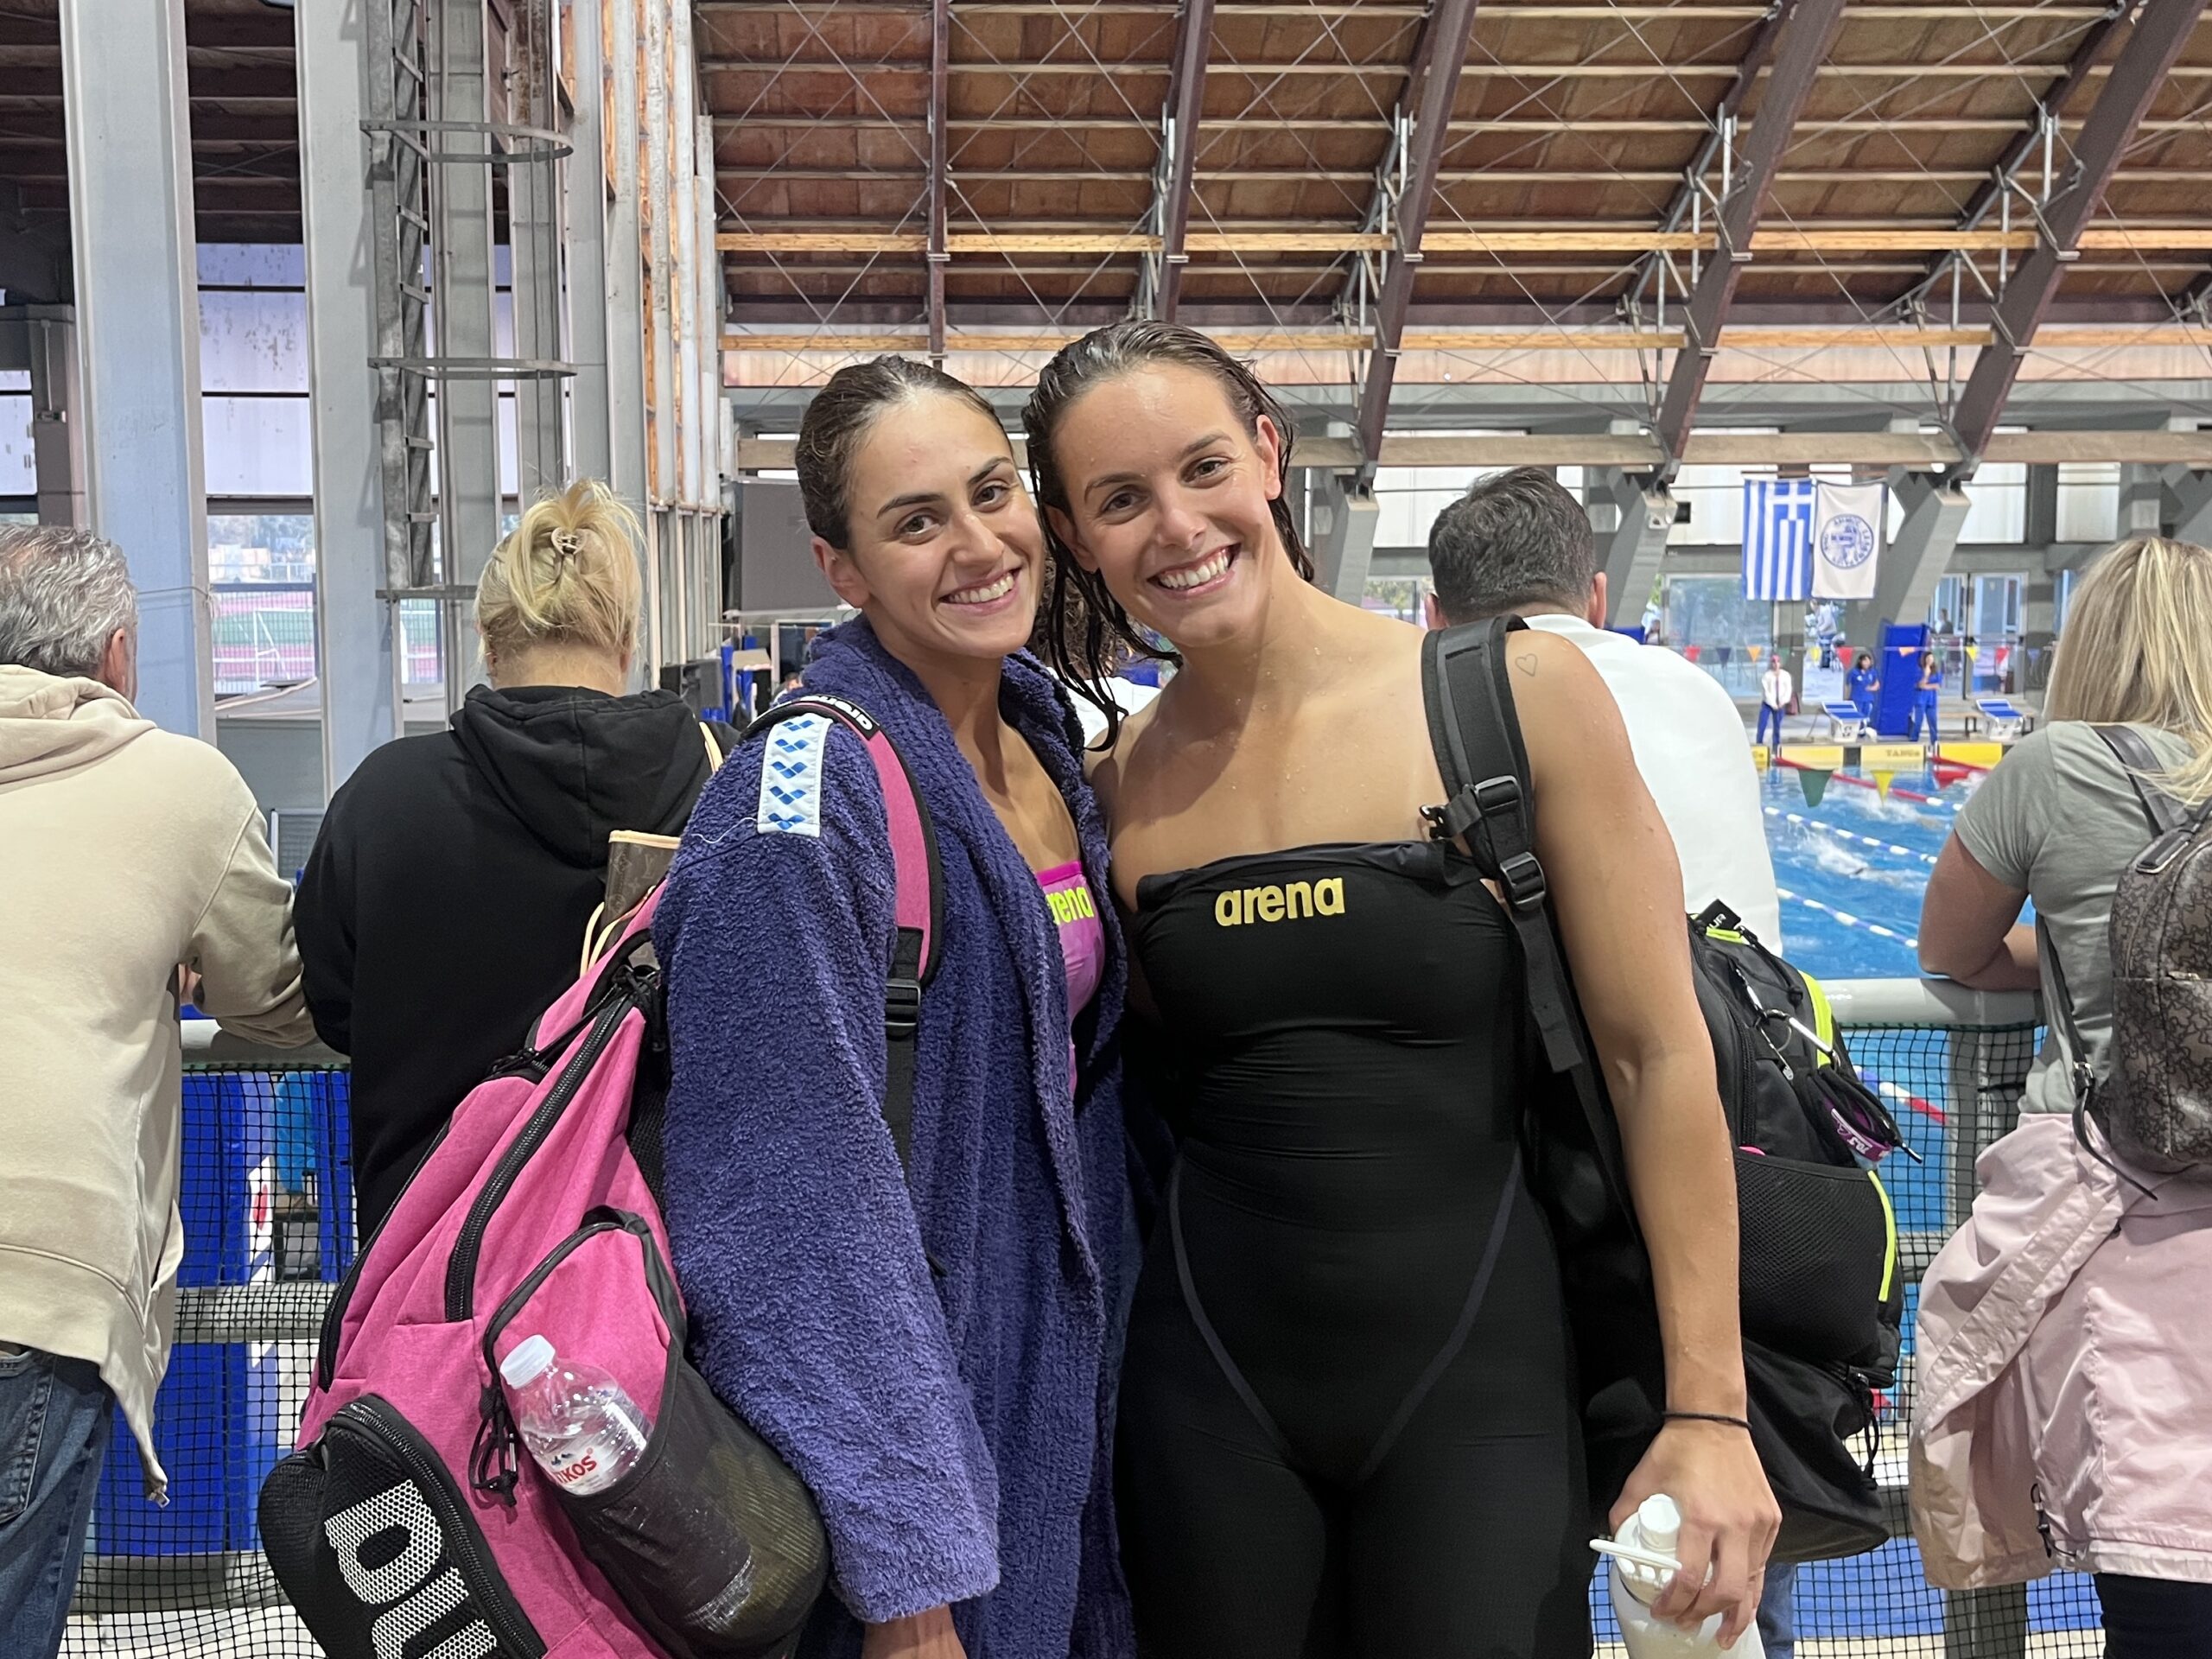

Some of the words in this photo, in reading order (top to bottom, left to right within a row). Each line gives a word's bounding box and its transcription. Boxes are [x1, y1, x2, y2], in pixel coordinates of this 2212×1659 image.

[1046, 887, 1094, 925] rena
[1215, 877, 1345, 927] arena
[1708, 913, 1726, 929] UR
[555, 1455, 597, 1484] IKOS
